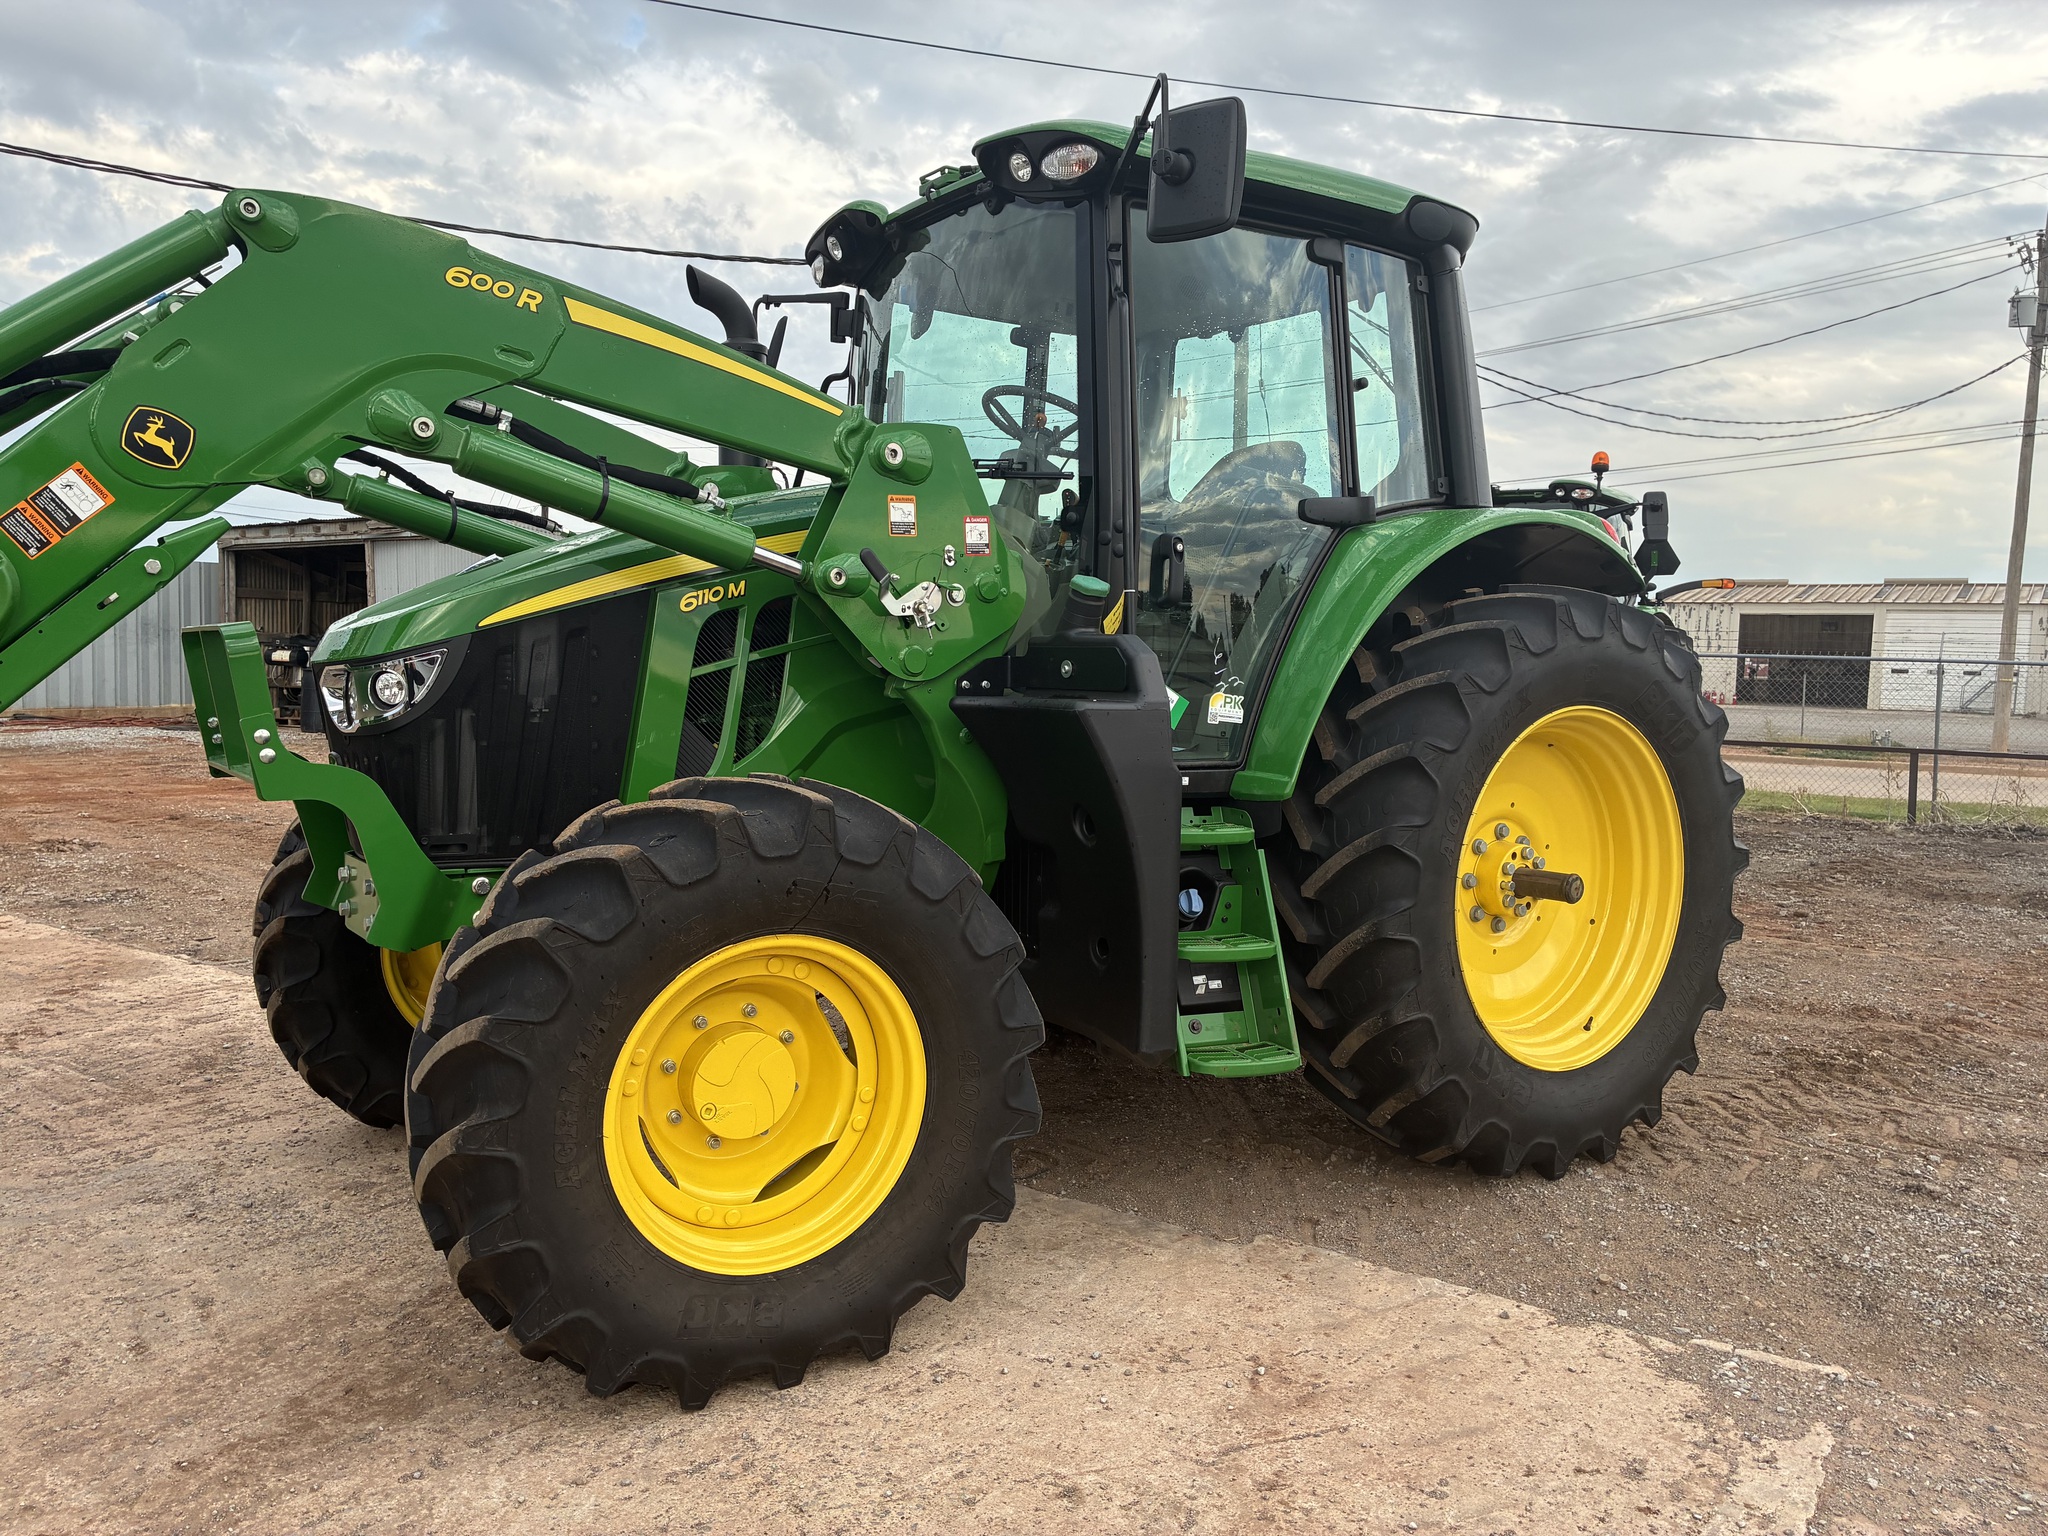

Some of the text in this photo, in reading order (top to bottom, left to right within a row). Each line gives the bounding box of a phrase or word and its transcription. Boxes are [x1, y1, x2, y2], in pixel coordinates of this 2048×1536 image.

[83, 473, 108, 500] WARNING
[28, 512, 54, 540] WARNING
[1223, 696, 1242, 711] PK
